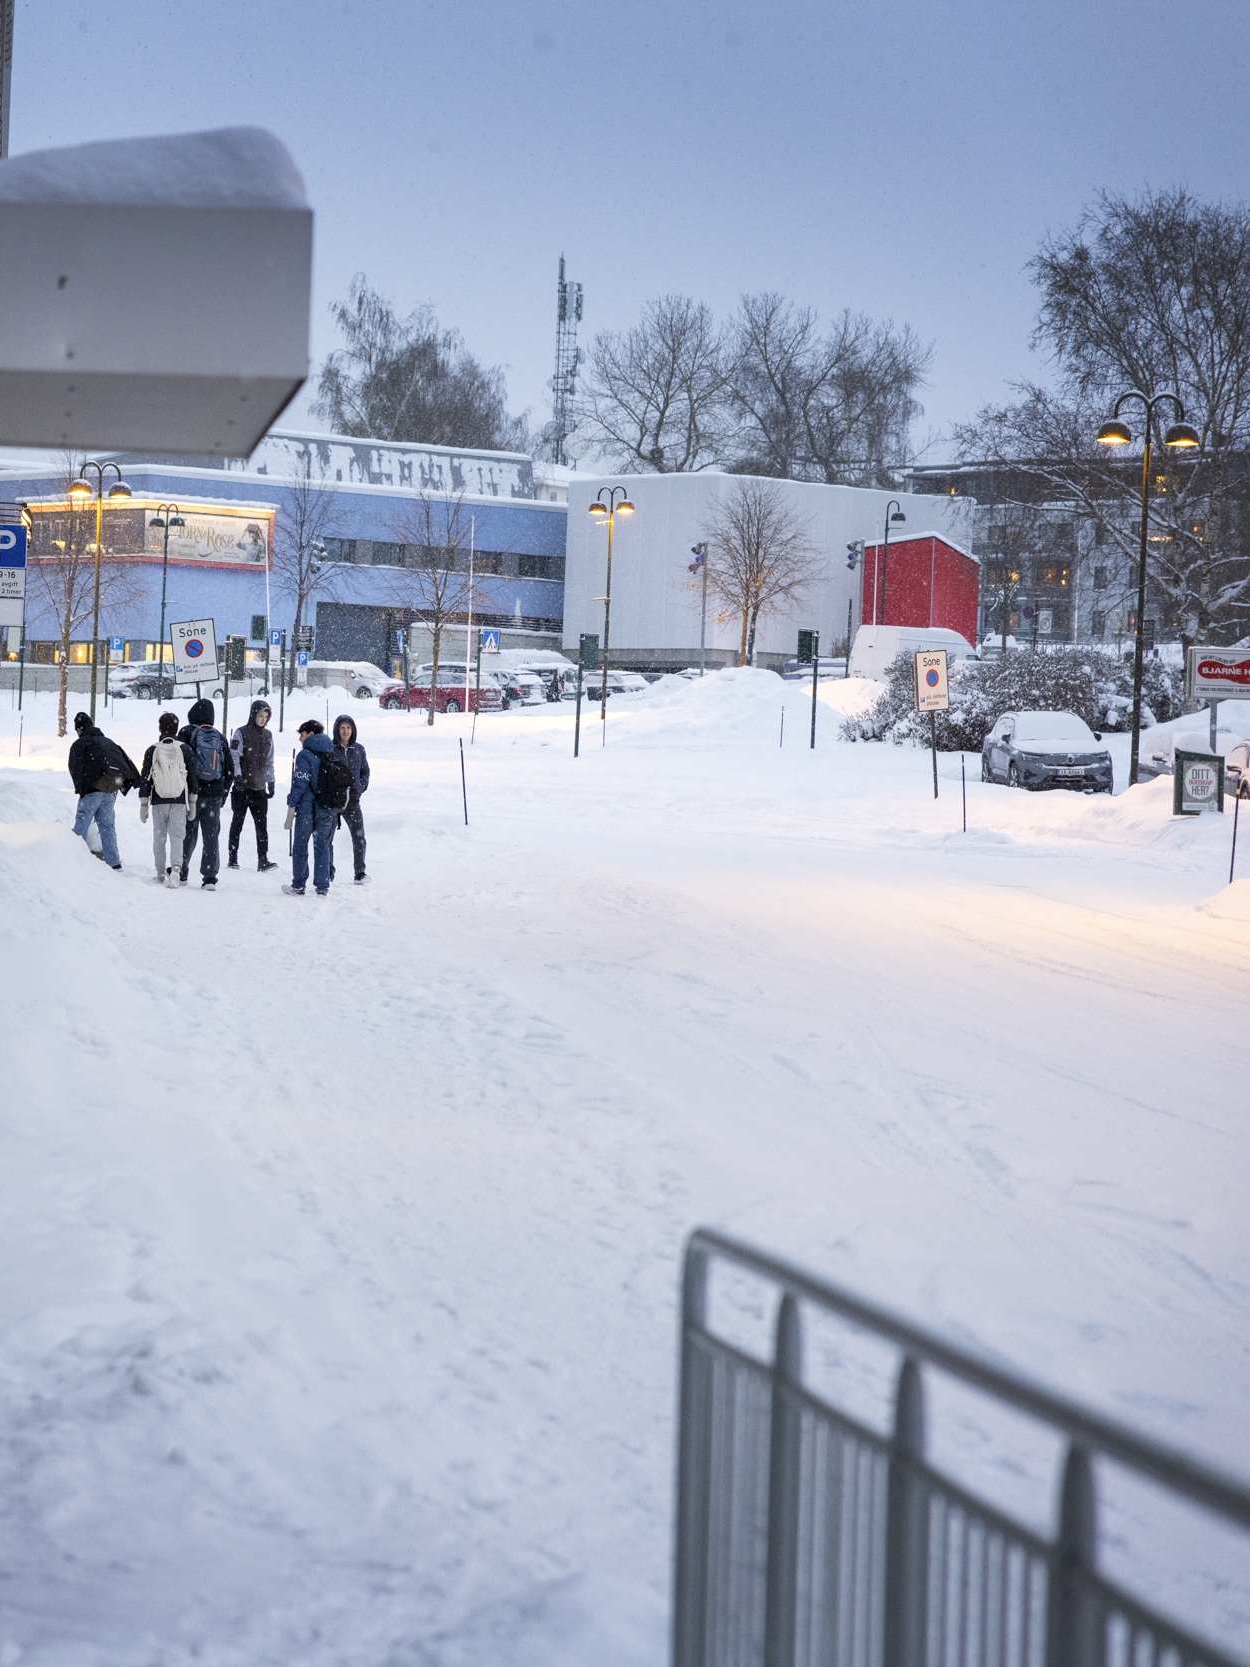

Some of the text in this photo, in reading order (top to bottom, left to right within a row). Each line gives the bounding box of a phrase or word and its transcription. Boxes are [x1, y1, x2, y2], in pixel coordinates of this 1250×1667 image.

[179, 627, 207, 638] Sone
[272, 631, 279, 644] P
[113, 638, 121, 649] P
[923, 657, 940, 666] Sone
[1192, 769, 1210, 779] DITT
[1192, 786, 1209, 795] HER?
